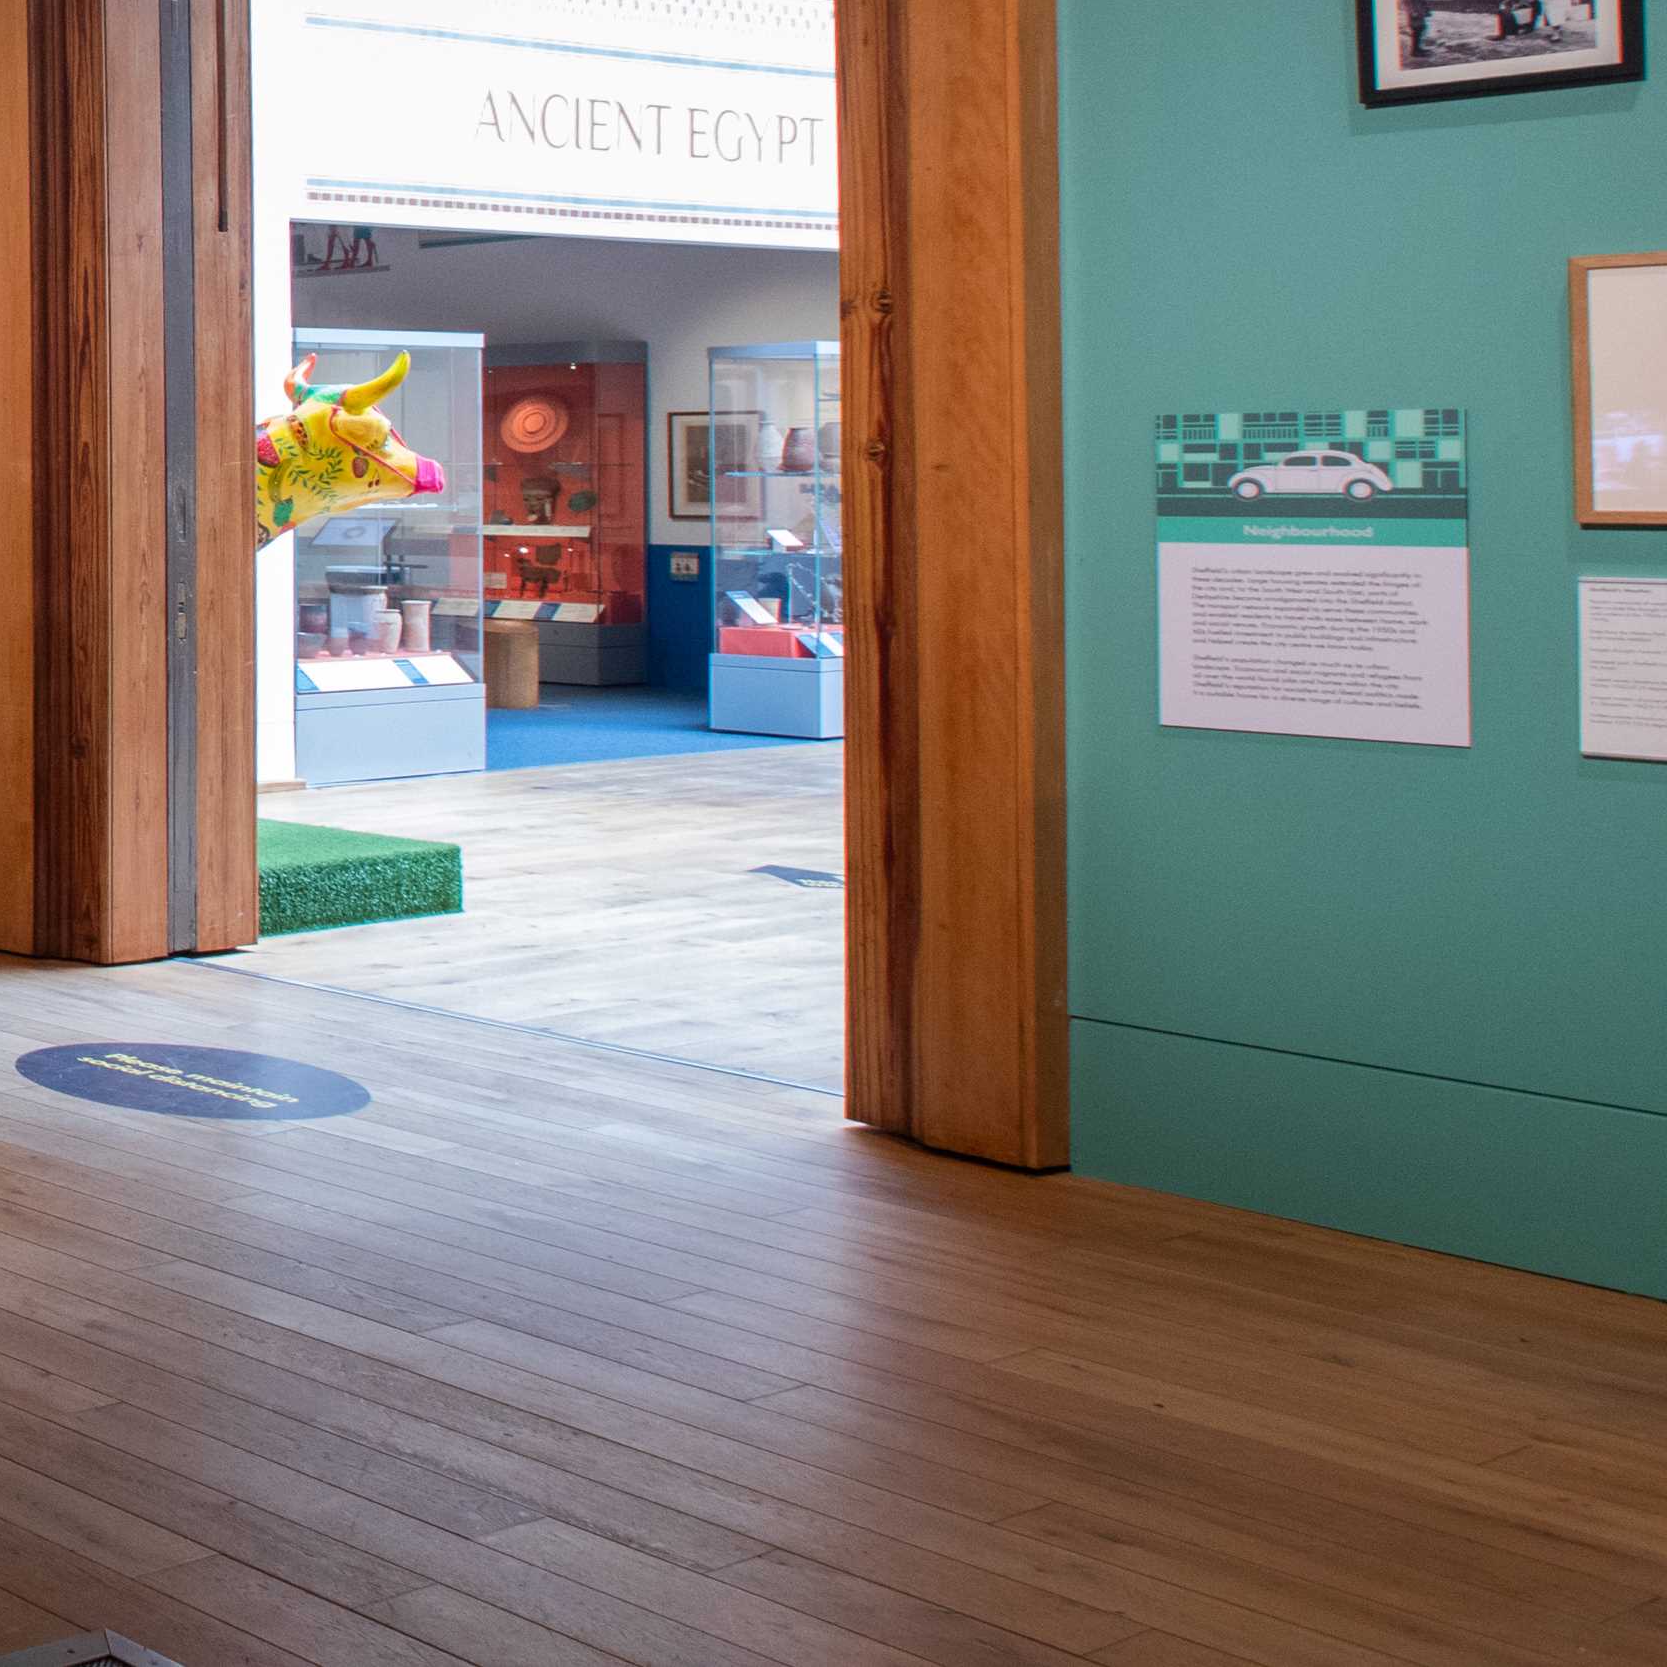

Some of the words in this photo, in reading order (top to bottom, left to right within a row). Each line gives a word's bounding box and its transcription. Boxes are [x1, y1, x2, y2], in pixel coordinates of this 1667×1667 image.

[474, 89, 672, 156] ANCIENT
[688, 107, 824, 166] EGYPT
[1242, 524, 1374, 540] Neighbourhood
[76, 1056, 157, 1076] social
[148, 1073, 279, 1109] distancing
[104, 1052, 184, 1075] Please
[186, 1073, 300, 1103] maintain
